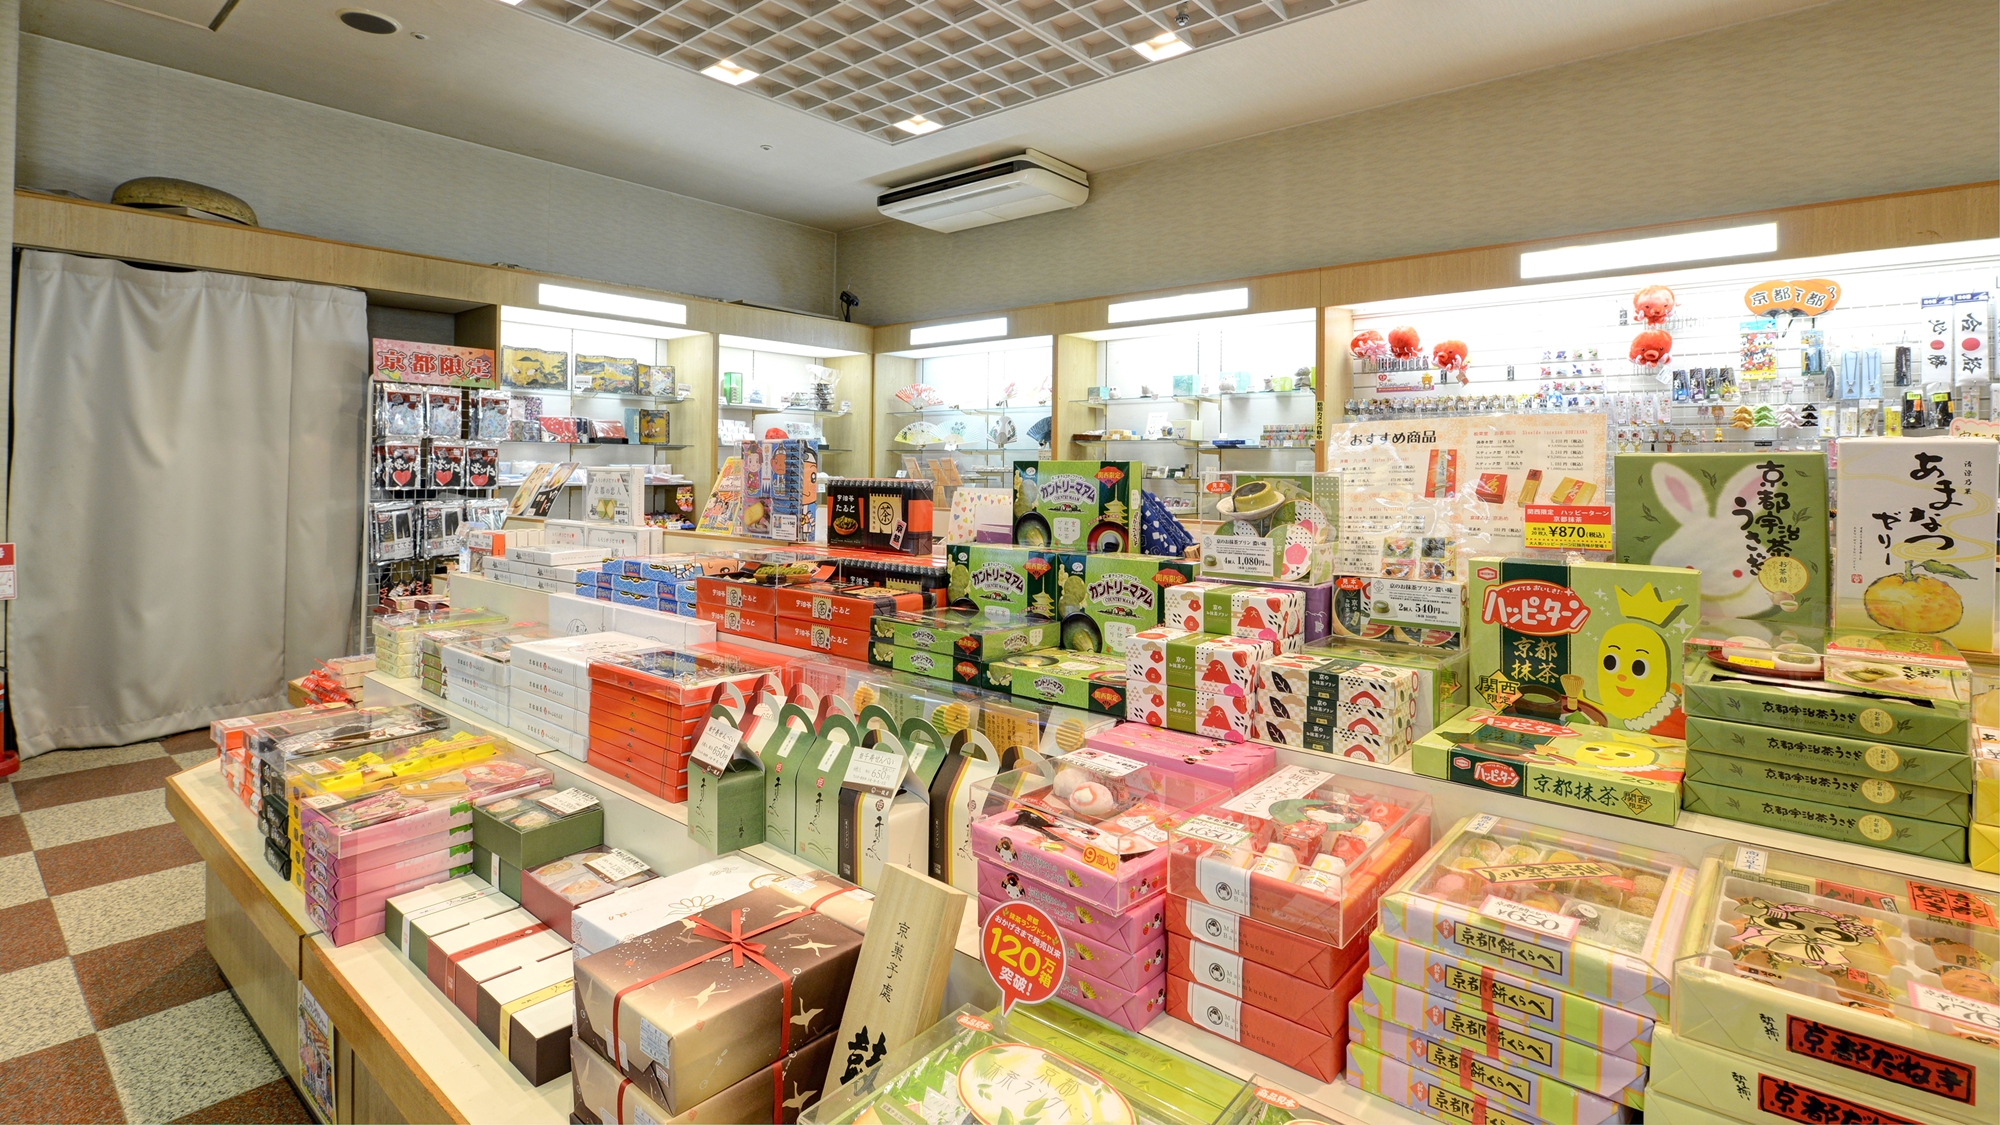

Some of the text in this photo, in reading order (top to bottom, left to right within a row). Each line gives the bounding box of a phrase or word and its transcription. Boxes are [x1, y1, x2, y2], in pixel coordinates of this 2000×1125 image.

[1751, 287, 1791, 306] 京都
[377, 349, 492, 379] 京都限定
[1350, 430, 1436, 447] おすすめ商品
[1040, 480, 1096, 503] カントリーマアム
[1904, 452, 1963, 550] あまなつ
[836, 504, 855, 513] たると
[880, 504, 891, 522] 茶
[1755, 460, 1800, 557] 京都宇治茶
[1732, 496, 1766, 576] うさぎ
[1872, 511, 1901, 565] ゼリー
[971, 568, 1024, 593] カントリーマアム
[1155, 573, 1183, 583] 関西限定
[742, 594, 757, 603] たると
[1088, 580, 1154, 608] カントリーマアム
[833, 605, 850, 615] たると
[1250, 609, 1258, 618] 大
[1484, 591, 1590, 628] ハッピーターン
[741, 617, 756, 626] たると
[830, 635, 848, 645] たると
[912, 632, 936, 643] カントリーマアム
[1512, 637, 1557, 661] 京都
[910, 656, 935, 668] カントリーマアム
[1215, 663, 1224, 672] 大
[1511, 659, 1560, 684] 抹茶
[1034, 679, 1064, 694] カントリーマアム
[1312, 680, 1336, 688] お抹茶プリン
[1487, 692, 1510, 706] 限定
[1169, 708, 1193, 716] お抹茶プリン
[1215, 709, 1224, 718] 大
[1309, 705, 1334, 714] お抹茶プリン
[1762, 701, 1857, 723] 京都宇治茶うさぎ
[1306, 732, 1331, 740] お抹茶プリン
[1475, 716, 1578, 736] ハッピーターン
[1767, 737, 1863, 761] 京都宇治茶うさぎ
[1475, 765, 1519, 787] ハッピーターン
[1764, 768, 1860, 792] 京都宇治茶うさぎ
[1533, 773, 1619, 807] 京都抹茶
[401, 813, 464, 834] CREAM SAND
[1762, 803, 1857, 828] 京都宇治茶うさぎ
[440, 854, 464, 865] SAND
[1083, 845, 1117, 872] 9個入り
[1234, 888, 1259, 902] Maiko
[1009, 911, 1052, 942] 抹茶ラングドシャ
[1027, 913, 1040, 925] 京都
[994, 914, 1062, 959] おかげさまで発売以来
[1223, 924, 1247, 939] Maiko
[991, 927, 1041, 977] 120
[1223, 932, 1275, 956] Baumkuchen
[1461, 926, 1555, 970] 京都餅くらべ
[1226, 969, 1250, 984] Maiko
[1226, 977, 1278, 1003] Baumkuchen
[1224, 1013, 1248, 1028] Maiko
[1224, 1021, 1276, 1049] Baumkuchen
[1033, 1065, 1081, 1097] 京都
